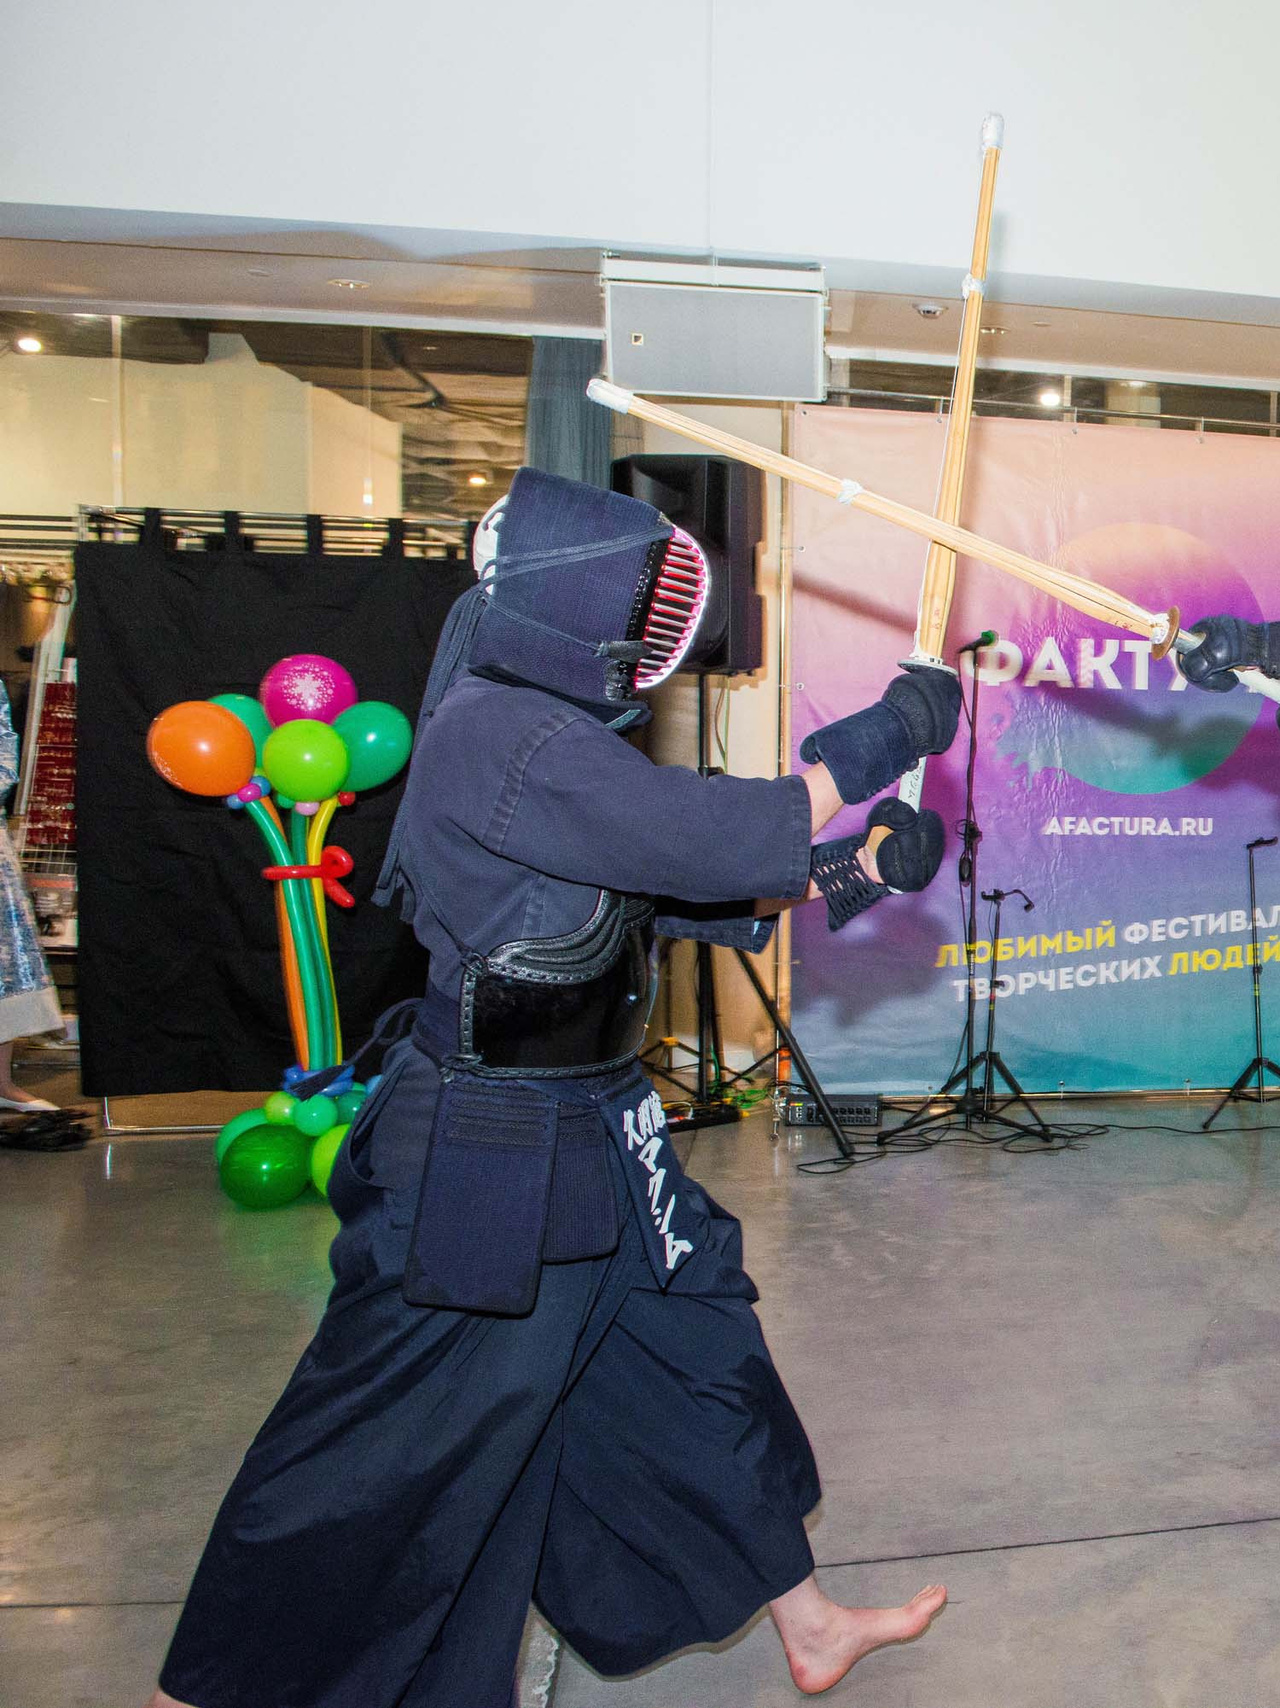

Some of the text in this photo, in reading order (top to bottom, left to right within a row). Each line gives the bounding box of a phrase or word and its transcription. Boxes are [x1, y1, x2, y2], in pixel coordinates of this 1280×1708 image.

[963, 635, 1257, 693] ФАКТ
[1042, 815, 1214, 837] AFACTURA.RU
[935, 920, 1117, 968] ЛЮБИМЫЙ
[953, 955, 1163, 1002] ТВОРЧЕСКИХ
